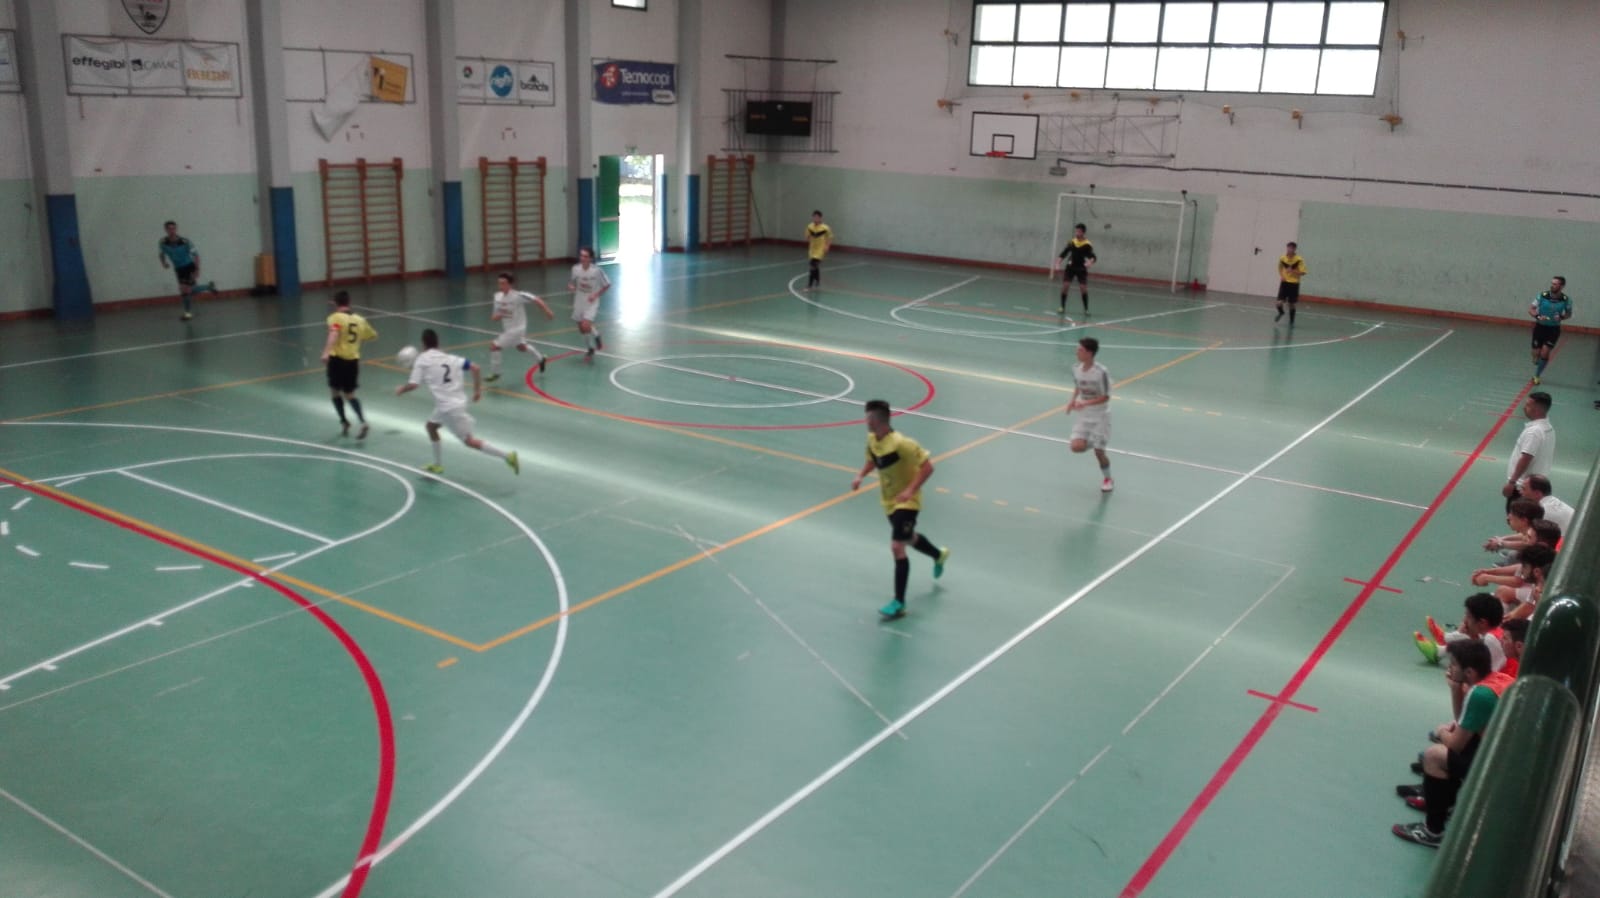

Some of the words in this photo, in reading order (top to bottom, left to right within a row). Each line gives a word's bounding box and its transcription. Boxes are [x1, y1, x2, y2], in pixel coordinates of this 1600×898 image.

[72, 55, 125, 71] effegibi
[619, 68, 671, 88] Tecnocopi
[346, 323, 358, 344] 5
[440, 364, 452, 383] 2
